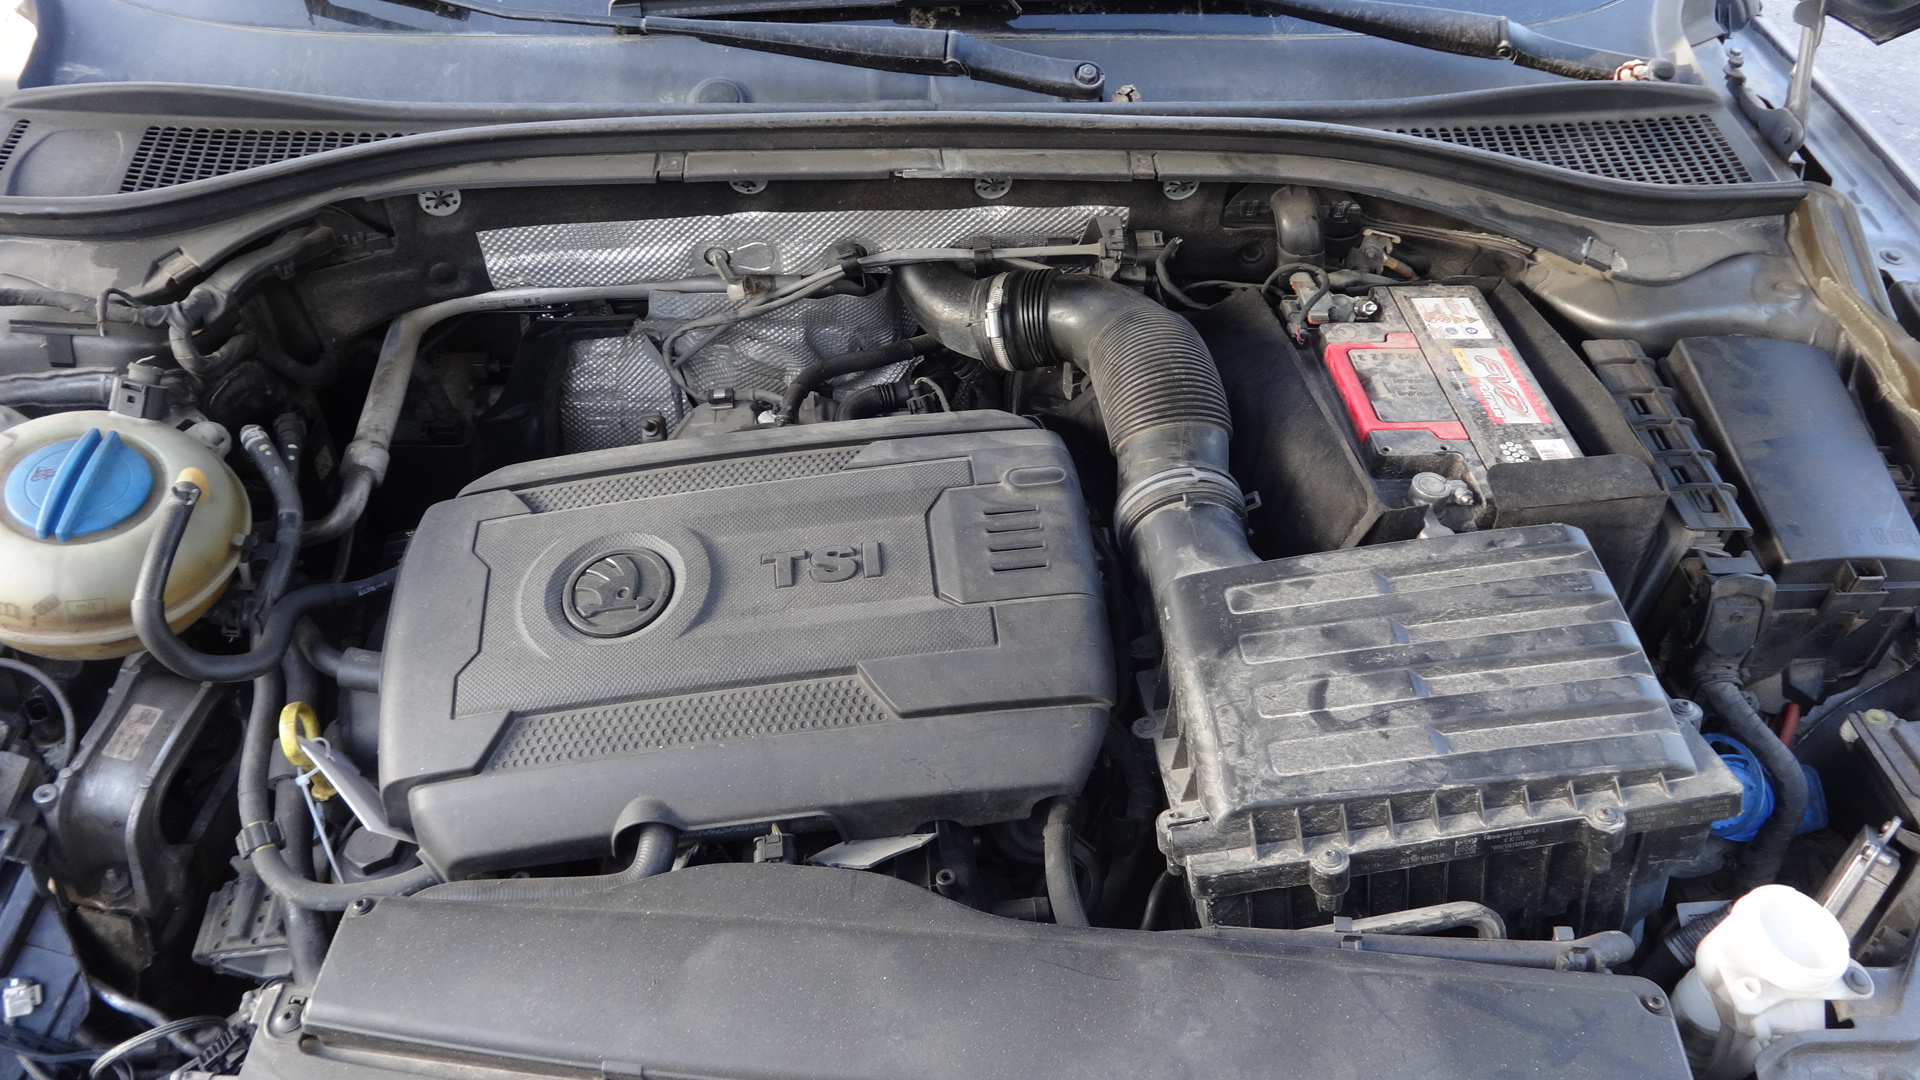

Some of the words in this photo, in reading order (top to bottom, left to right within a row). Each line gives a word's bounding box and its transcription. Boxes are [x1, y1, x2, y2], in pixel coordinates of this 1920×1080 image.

[1475, 355, 1528, 413] FVP
[1477, 381, 1505, 418] PLATINUM
[761, 541, 883, 589] TSI
